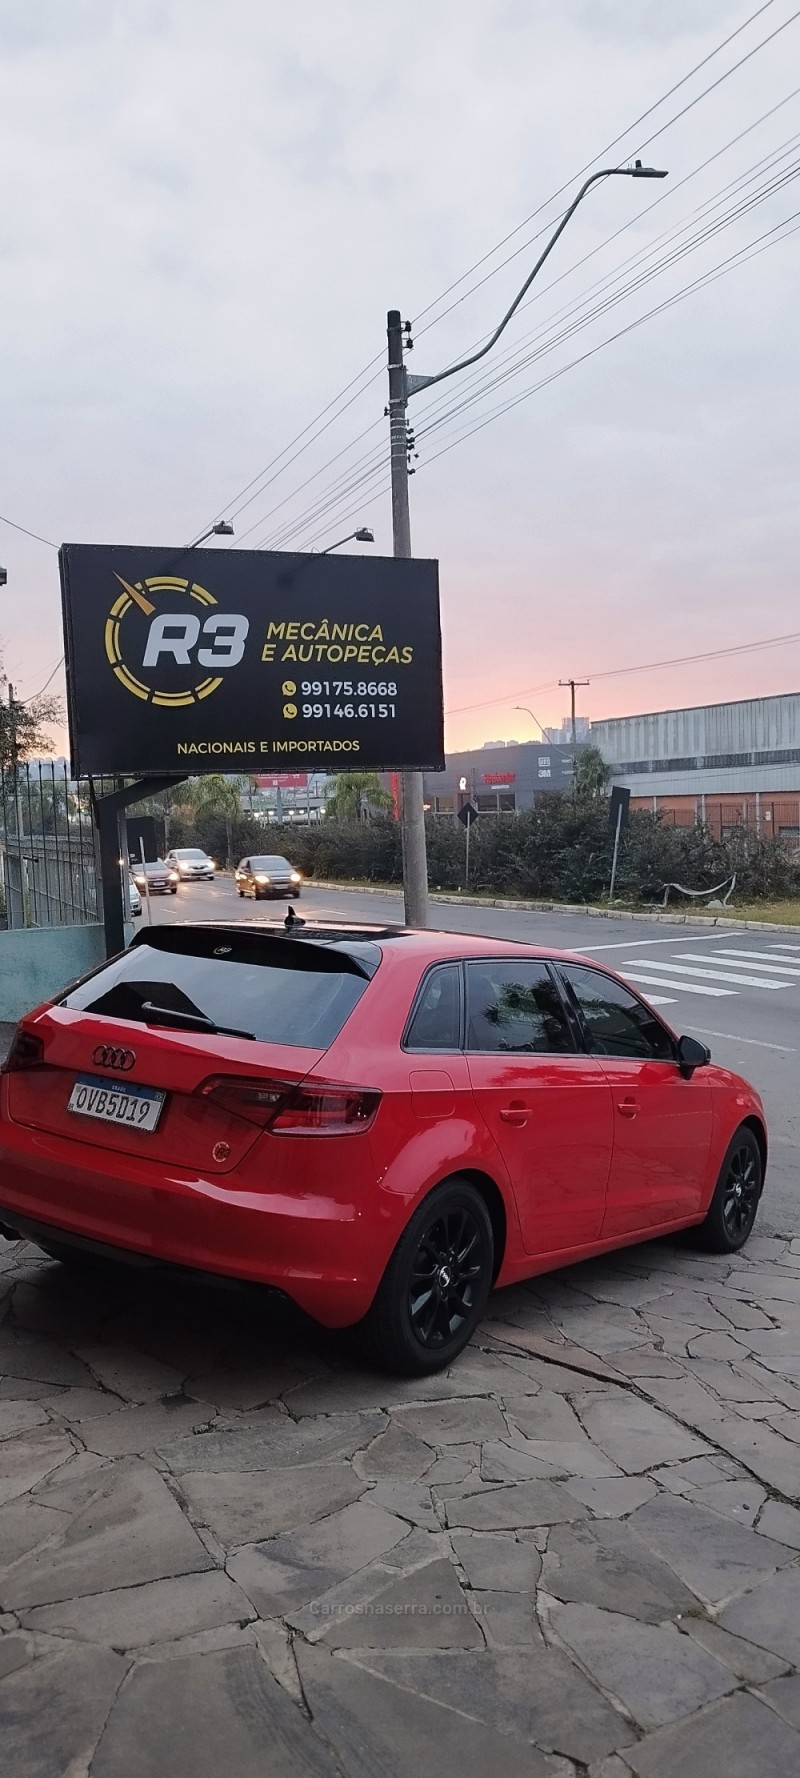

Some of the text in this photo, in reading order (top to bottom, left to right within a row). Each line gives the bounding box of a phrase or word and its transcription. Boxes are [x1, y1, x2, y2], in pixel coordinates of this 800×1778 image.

[266, 618, 384, 642] MECÂNICA
[142, 613, 250, 668] R3
[261, 644, 414, 666] E AUTOPEÇAS
[301, 681, 398, 697] 99175.8668
[302, 703, 397, 719] 99146.6151
[177, 740, 360, 755] NACIONAIS E IMPORTADOS
[538, 769, 551, 778] 3M
[76, 1087, 151, 1124] OVB5D19
